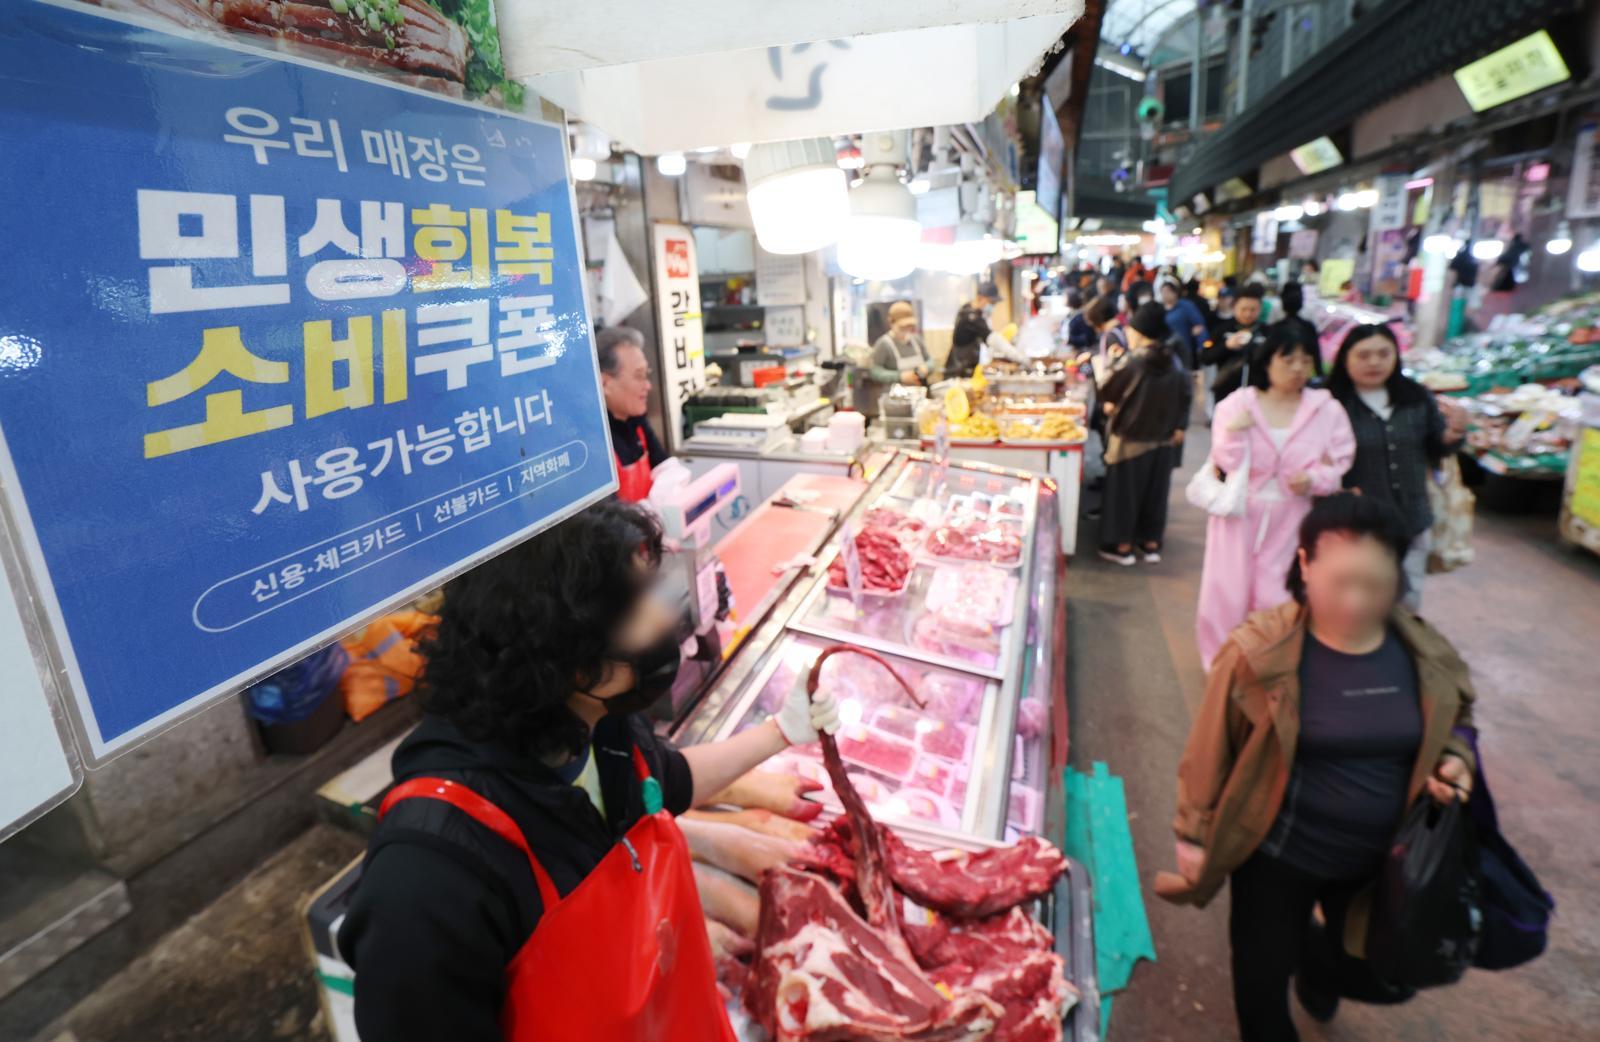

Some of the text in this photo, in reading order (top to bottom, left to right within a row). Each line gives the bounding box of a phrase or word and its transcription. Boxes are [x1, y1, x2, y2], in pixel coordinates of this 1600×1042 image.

[224, 106, 487, 188] 우리 매장은
[137, 188, 555, 315] 민생회복
[144, 294, 558, 459] 소비쿠폰
[251, 388, 554, 515] 사용가능합니다
[433, 480, 501, 524] 선불카드
[520, 451, 570, 484] 지역화폐
